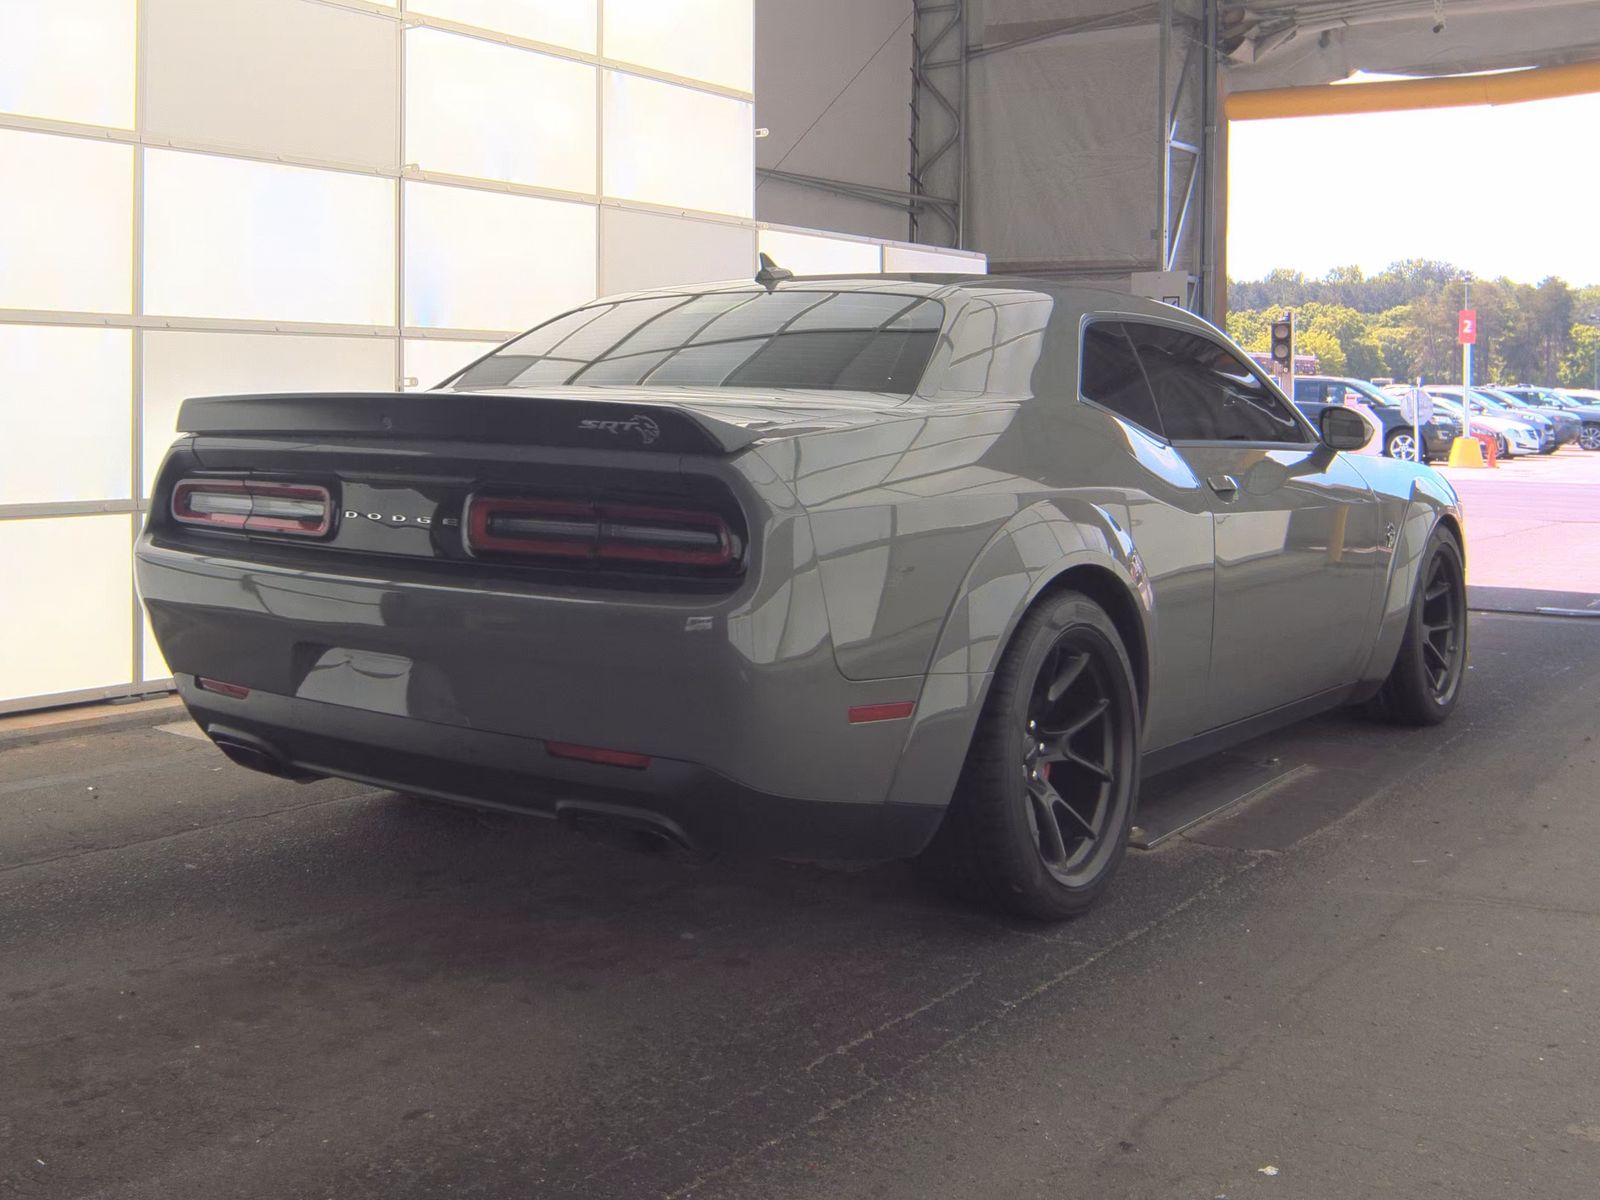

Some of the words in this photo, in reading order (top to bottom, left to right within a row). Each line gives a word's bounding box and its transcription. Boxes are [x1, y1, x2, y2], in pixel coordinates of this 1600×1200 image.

[1463, 319, 1472, 334] 2
[577, 419, 639, 435] SRT
[344, 510, 458, 526] DODGE
